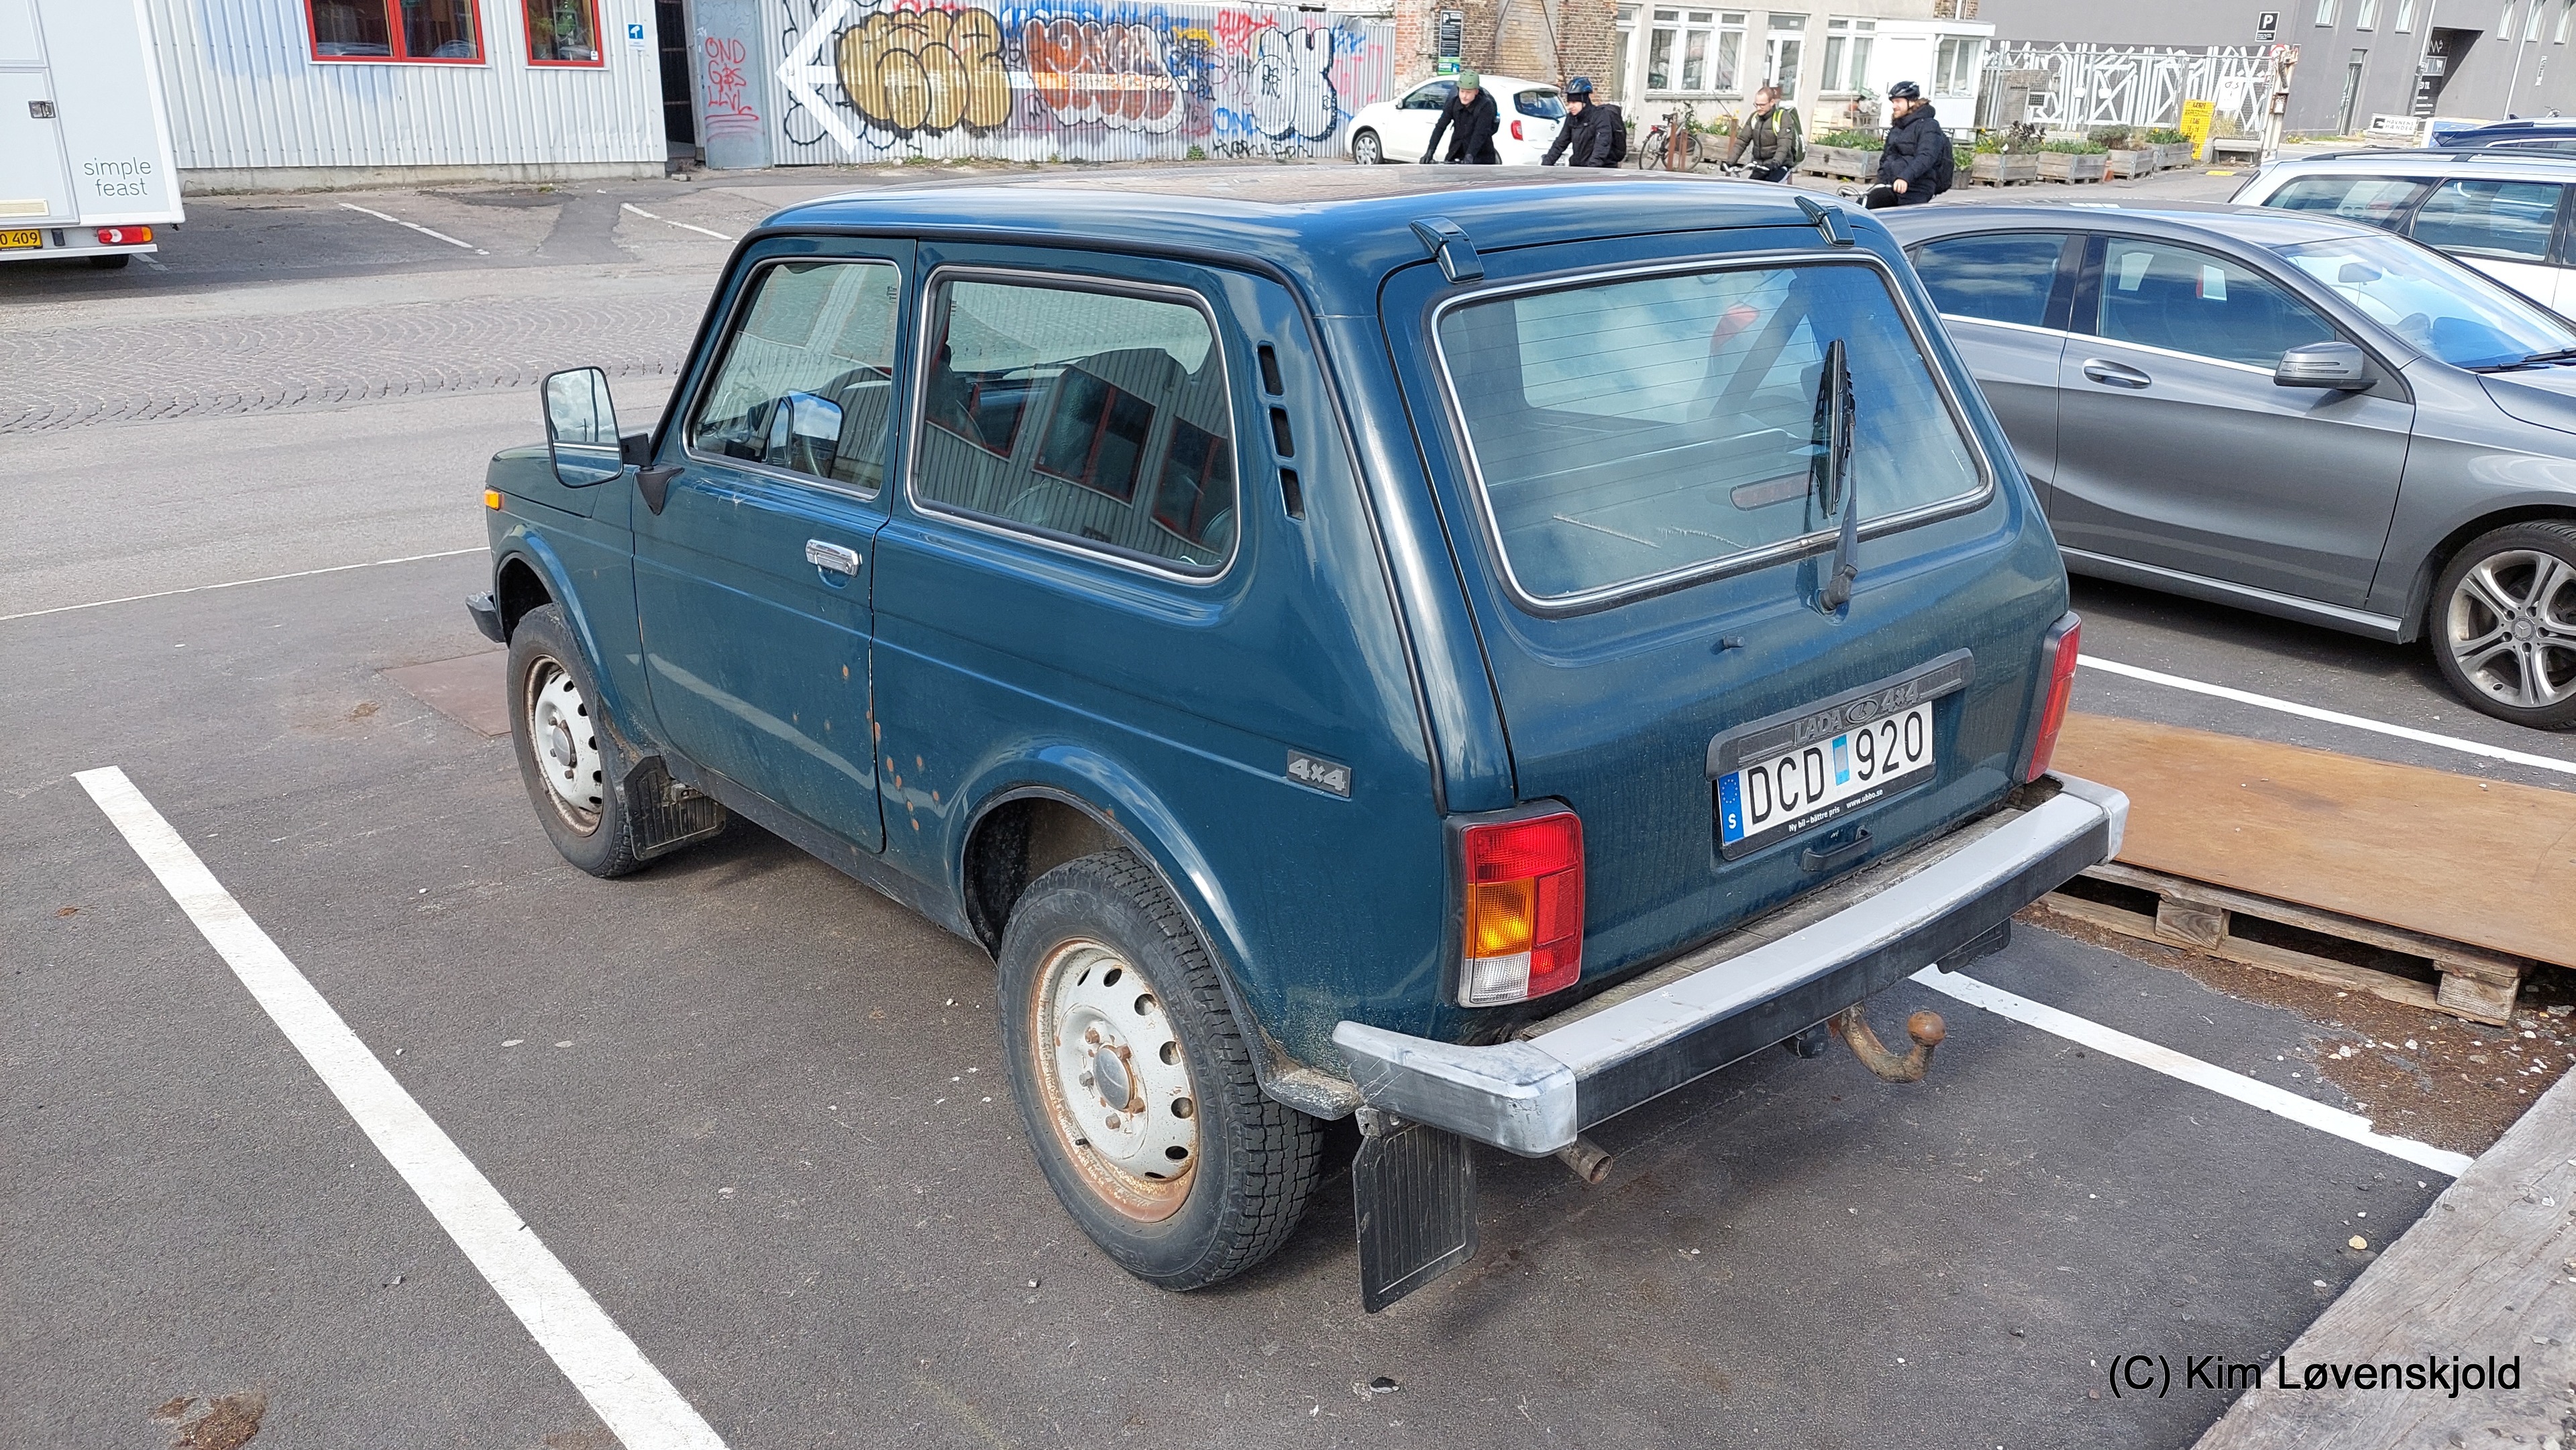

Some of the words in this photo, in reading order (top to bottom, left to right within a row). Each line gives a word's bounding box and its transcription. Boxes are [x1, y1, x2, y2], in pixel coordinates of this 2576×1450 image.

[2262, 15, 2273, 29] P
[705, 37, 746, 64] OND
[84, 157, 152, 180] simple
[95, 178, 148, 196] feast
[12, 232, 38, 244] 409
[1794, 709, 1843, 744] LADA
[1289, 758, 1346, 791] 4x4
[1747, 747, 1825, 825] DCD
[1856, 711, 1923, 781] 920
[1728, 813, 1737, 829] S
[1788, 824, 1797, 832] Ny
[1798, 820, 1806, 828] bil
[1810, 811, 1828, 824] bättre
[1829, 805, 1840, 818] pris
[1846, 789, 1884, 809] www.ubbo.se
